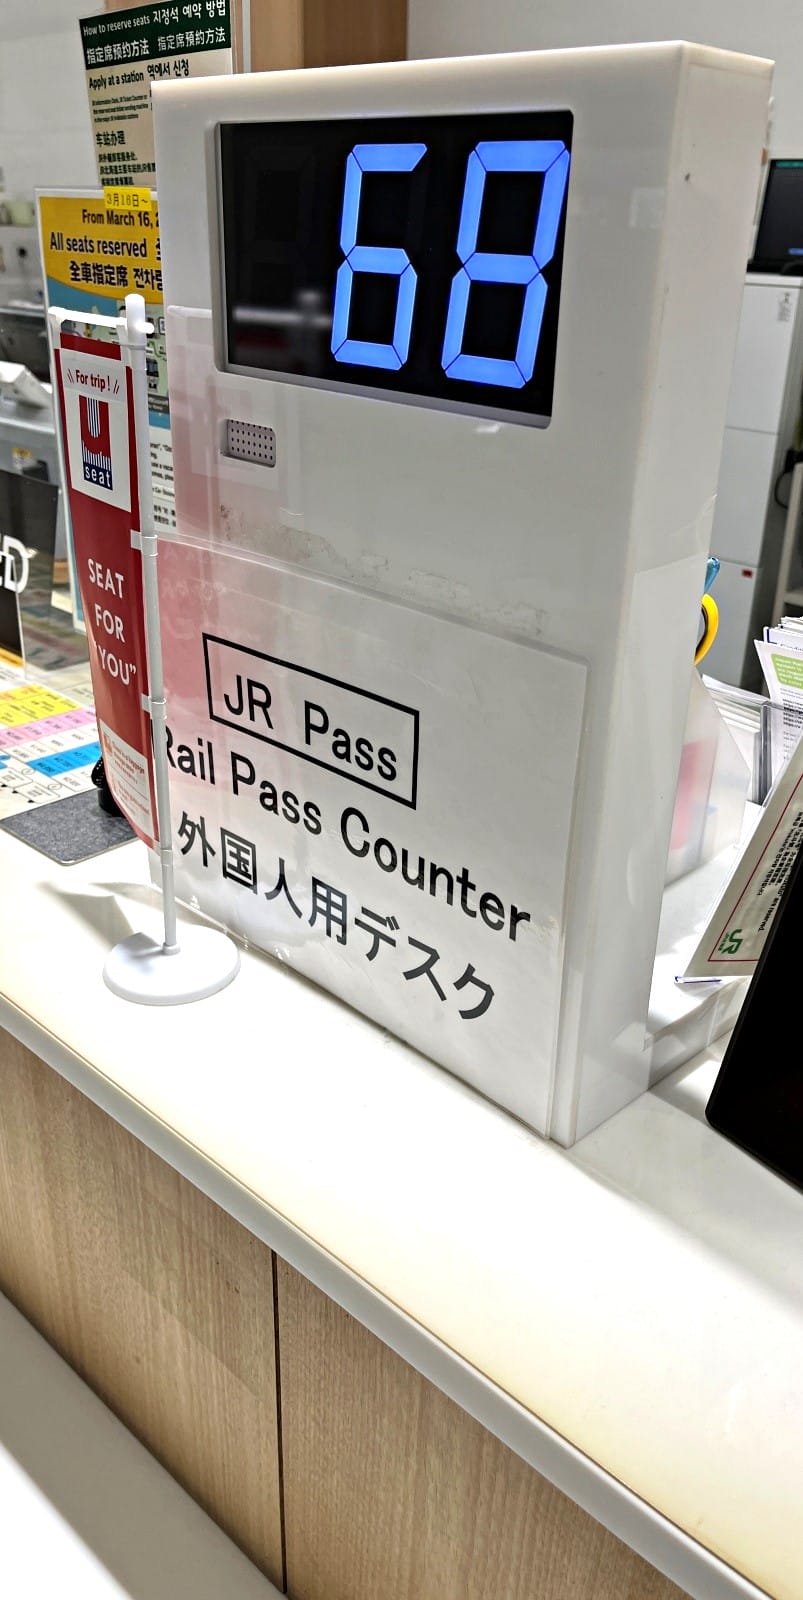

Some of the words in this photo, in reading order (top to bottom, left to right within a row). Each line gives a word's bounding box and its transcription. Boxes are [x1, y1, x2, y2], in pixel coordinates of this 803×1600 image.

[83, 26, 98, 36] How
[98, 24, 106, 33] to
[107, 19, 132, 32] reserve
[133, 14, 150, 27] seats
[152, 6, 179, 25] 지정석
[182, 3, 202, 19] 예약
[205, 0, 226, 18] 방법
[86, 38, 150, 64] 指定席预约方法
[158, 26, 226, 51] 指定席預約方法
[89, 75, 107, 91] Apply
[108, 75, 115, 86] at
[121, 70, 144, 83] station
[147, 61, 171, 80] 역에서
[173, 59, 189, 77] 신청
[82, 209, 104, 225] From
[106, 210, 135, 226] March
[138, 211, 154, 229] 16,
[50, 231, 64, 251] All
[66, 236, 95, 253] seats
[97, 238, 148, 258] reserved
[69, 260, 129, 288] 全車指定席
[330, 140, 571, 389] 68
[75, 369, 88, 385] For
[85, 465, 112, 487] seat
[88, 558, 124, 599] SEAT
[94, 603, 126, 643] FOR
[223, 674, 274, 730] JR
[303, 700, 398, 782] Pass
[230, 751, 322, 836] Pass
[340, 806, 531, 942] Counter
[177, 811, 495, 1020] 外国人用デスク
[721, 929, 743, 954] JR
